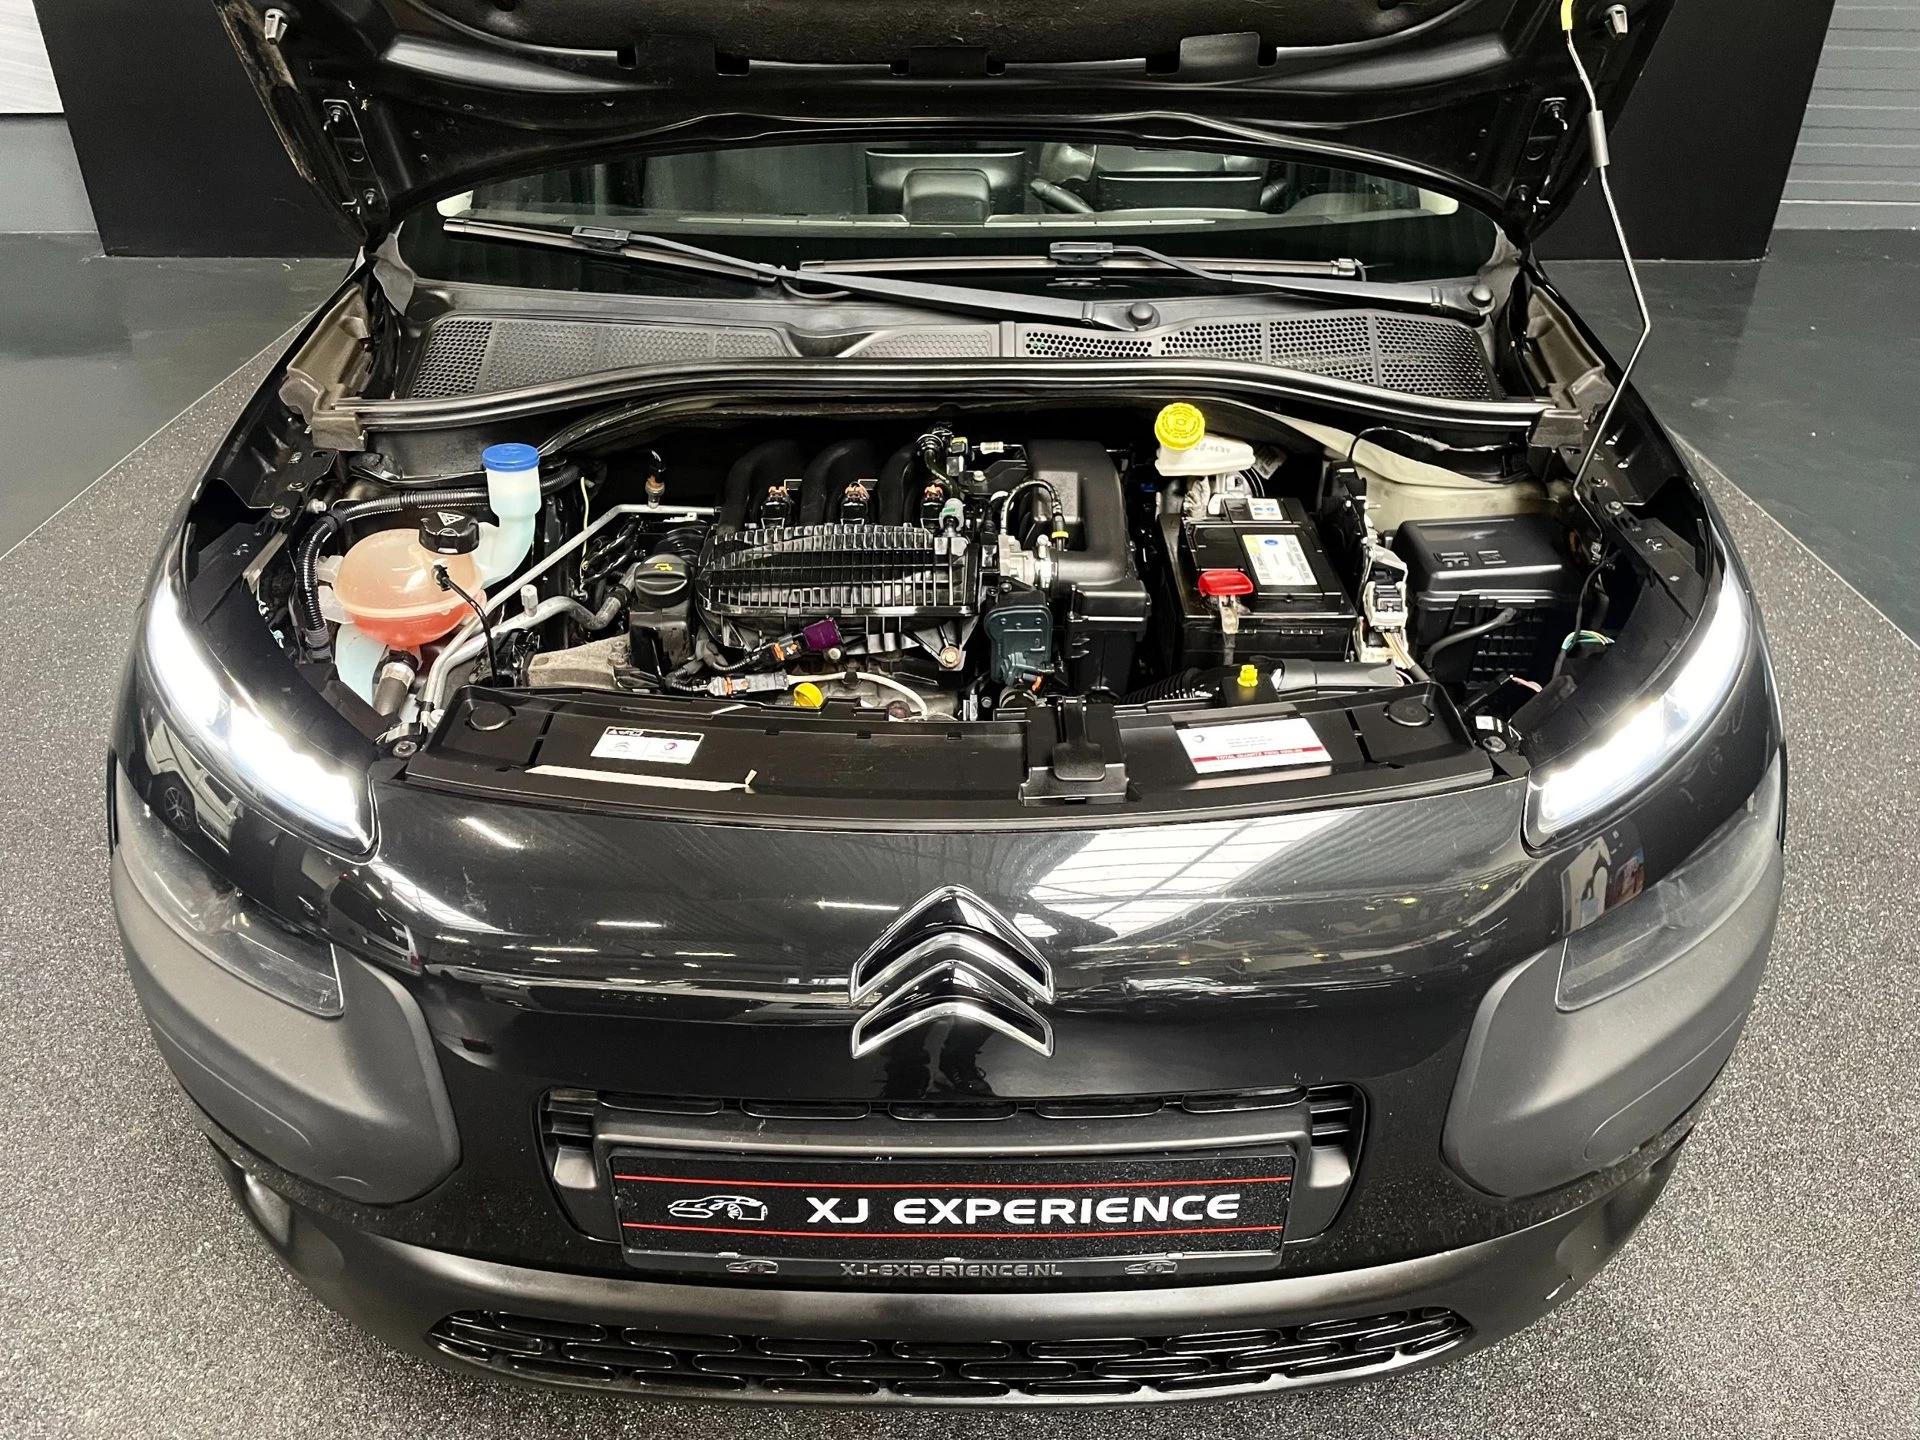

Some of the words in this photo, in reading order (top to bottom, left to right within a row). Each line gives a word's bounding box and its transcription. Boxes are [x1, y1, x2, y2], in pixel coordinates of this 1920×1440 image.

[806, 1197, 869, 1224] XJ
[893, 1194, 1241, 1225] EXPERIENCE
[840, 1263, 1063, 1277] XJ-EXPERIENCE.NL
